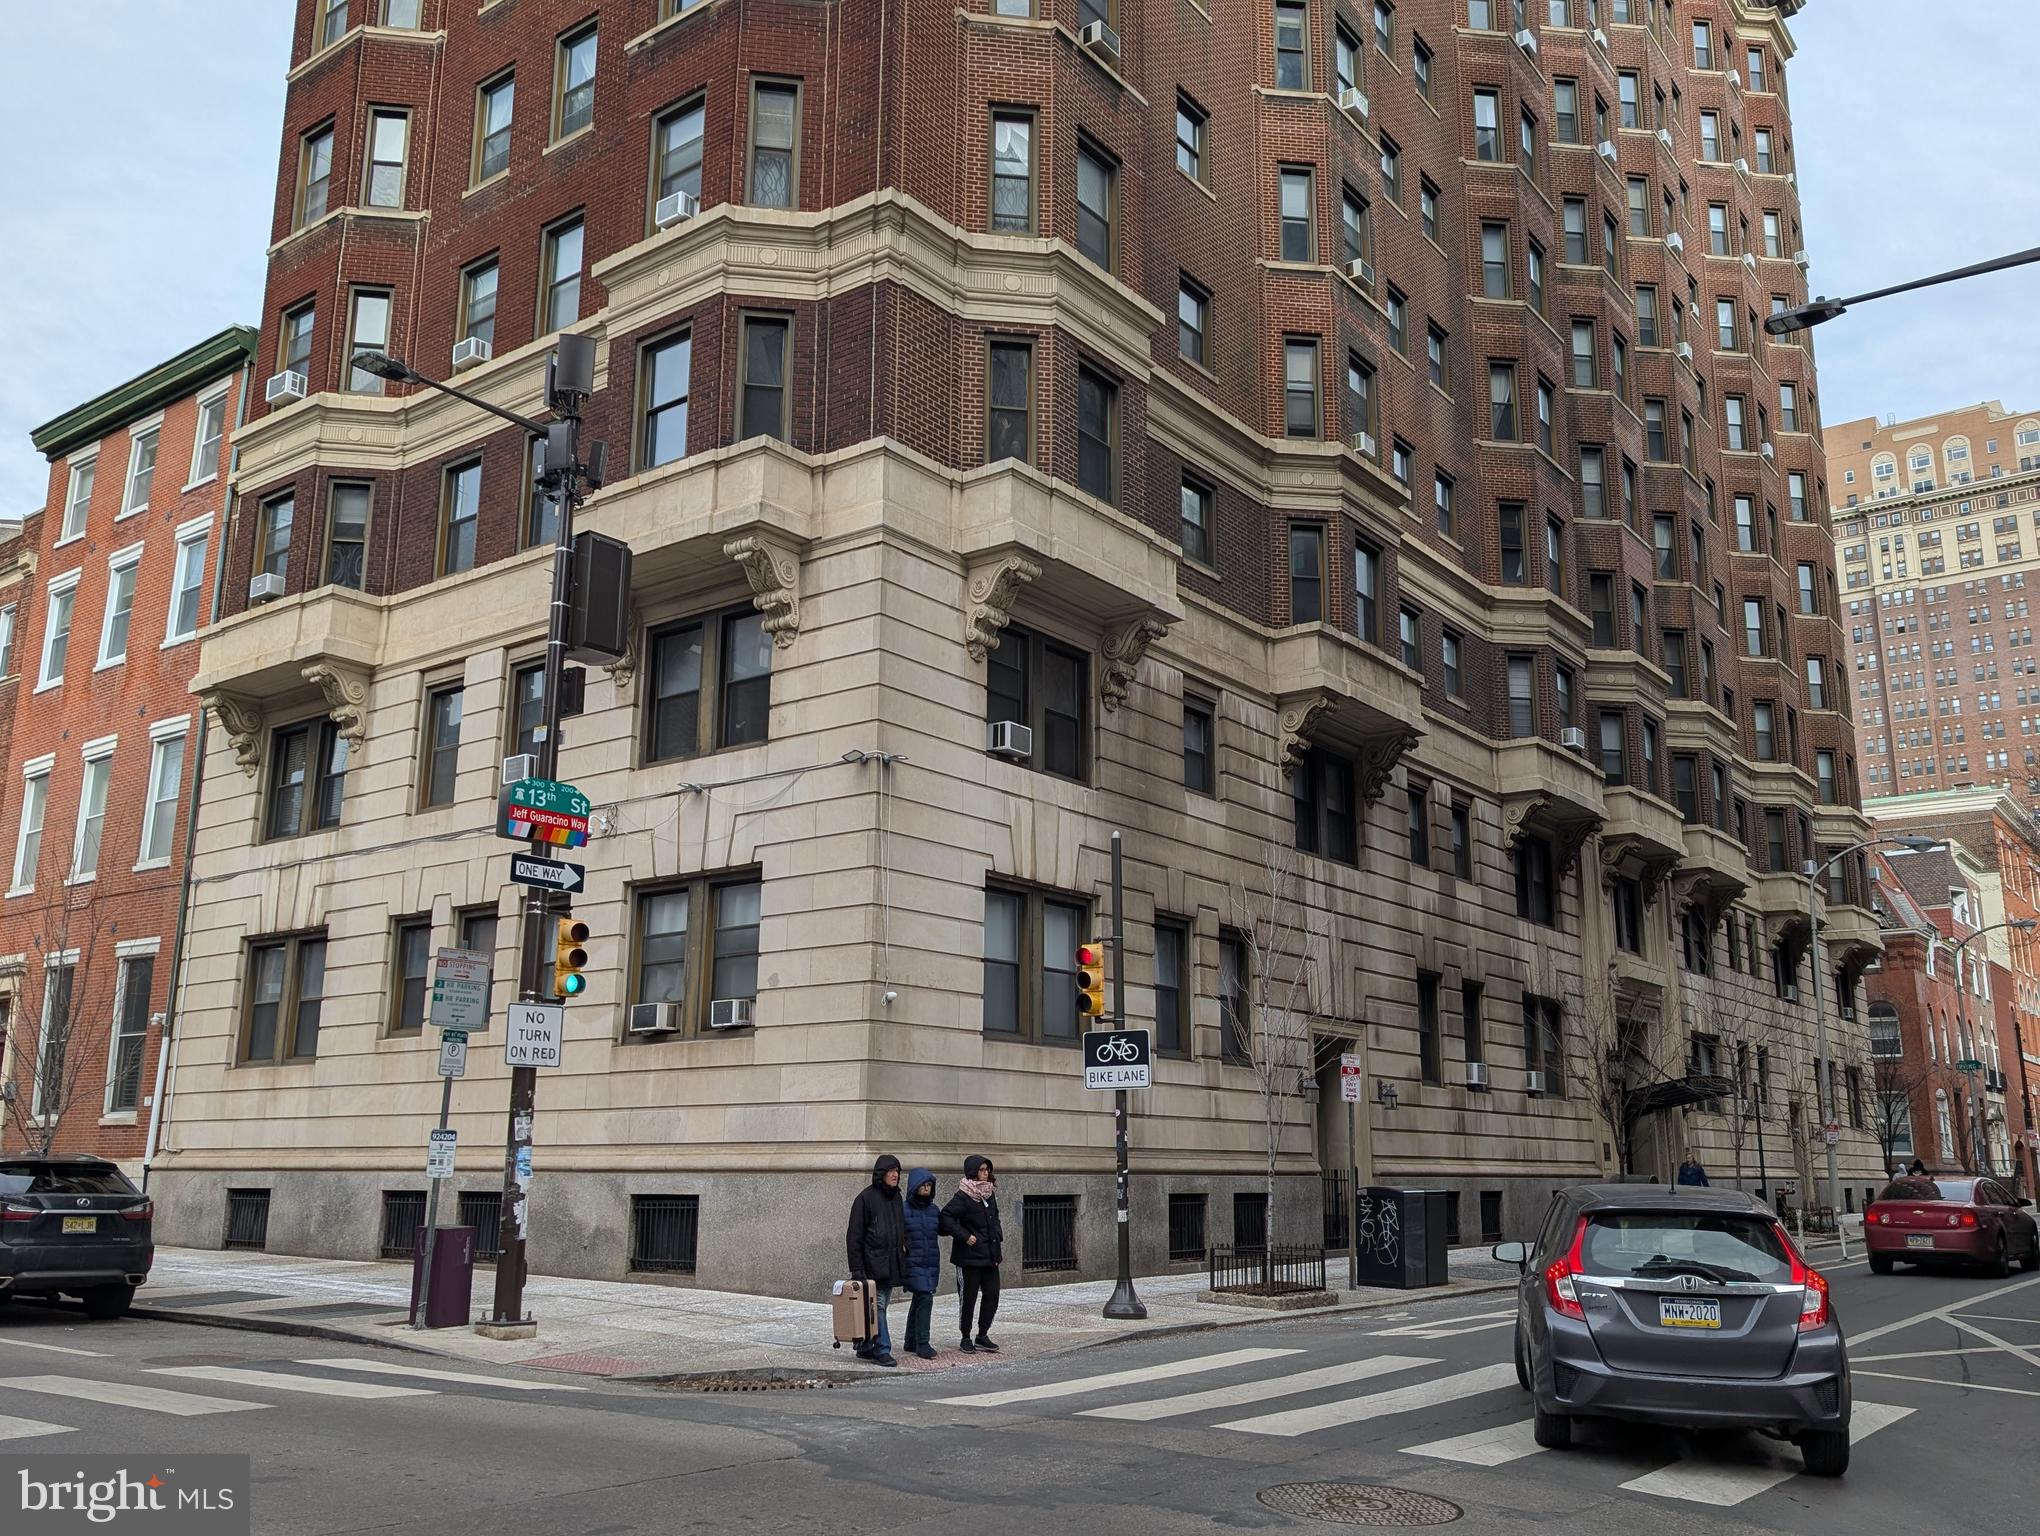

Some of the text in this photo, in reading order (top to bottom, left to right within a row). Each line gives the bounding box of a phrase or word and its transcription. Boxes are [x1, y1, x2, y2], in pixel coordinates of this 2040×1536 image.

[549, 783, 556, 791] S
[561, 786, 574, 794] 200
[528, 788, 587, 815] 13th St
[512, 807, 586, 832] Jeff Guaracino Way
[518, 863, 563, 880] ONE WAY
[449, 961, 476, 970] STOPPING
[457, 982, 481, 991] PARKING
[456, 996, 480, 1004] PARKING
[525, 1011, 545, 1024] NO
[519, 1028, 551, 1042] TURN
[510, 1045, 556, 1060] ON RED
[1089, 1070, 1145, 1083] BIKE LANE
[432, 1133, 456, 1141] 924204
